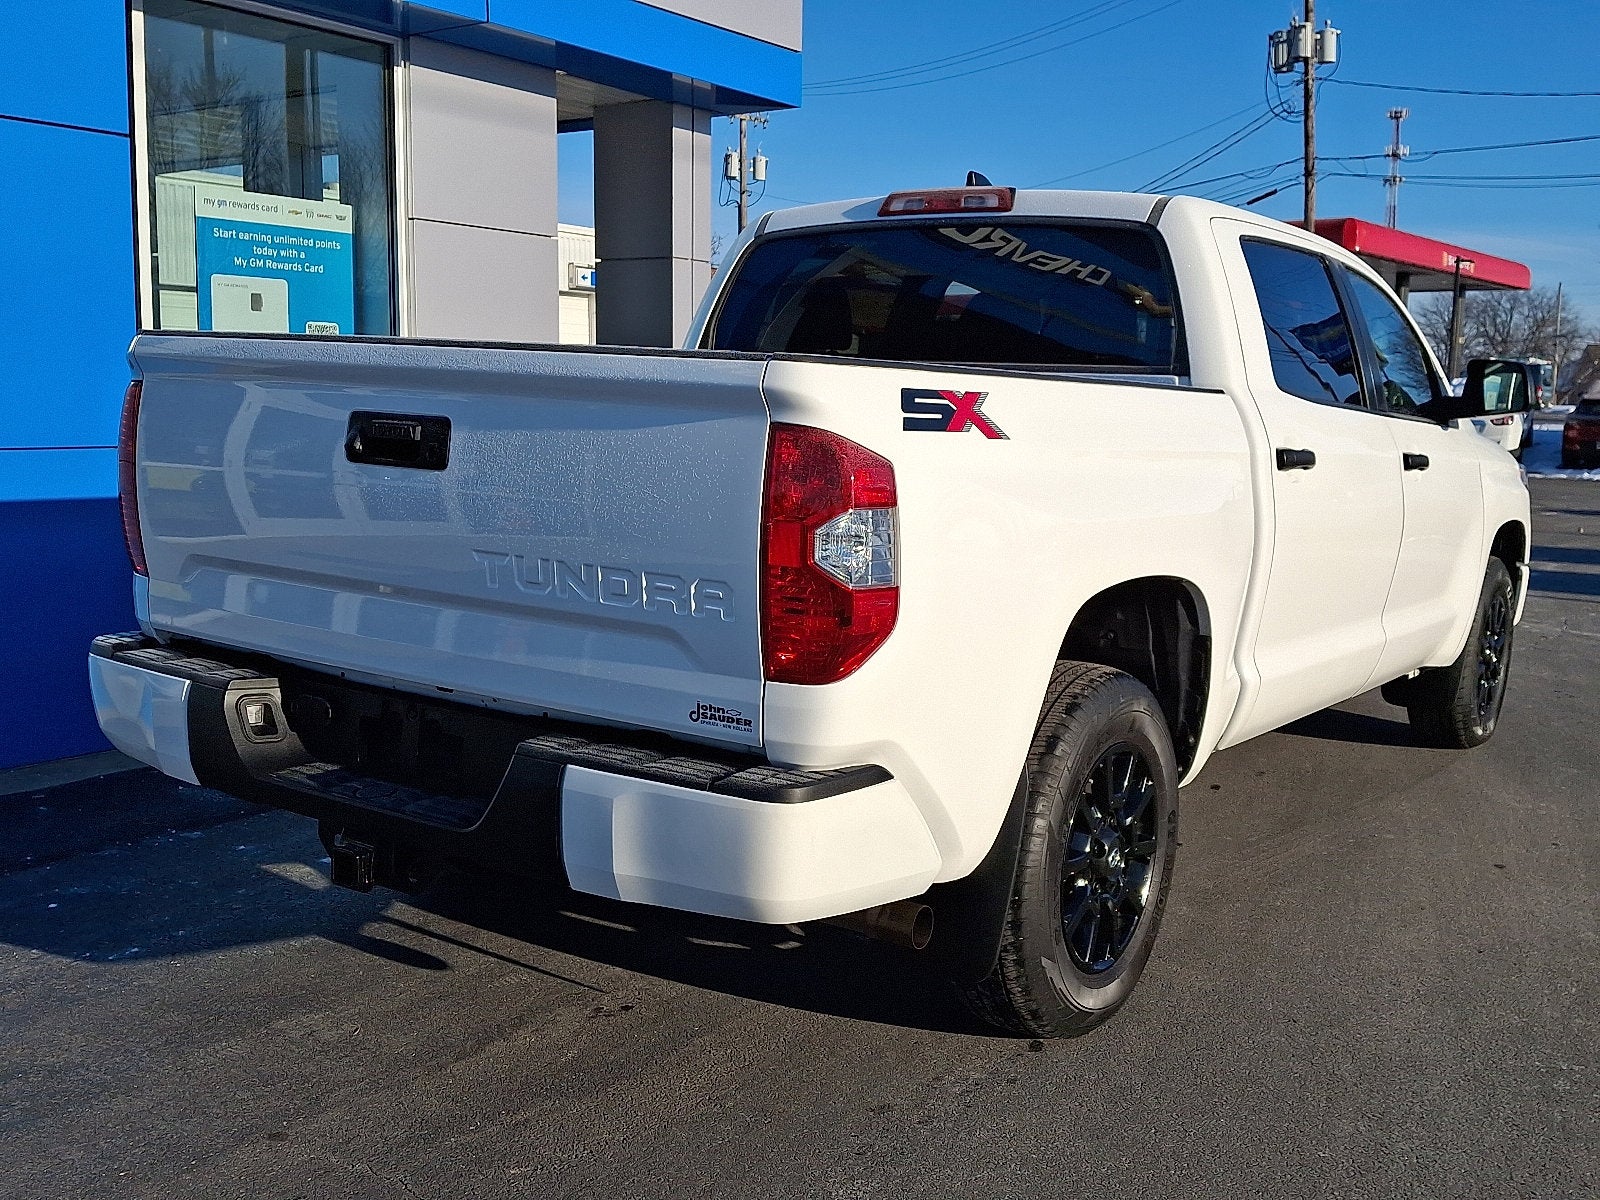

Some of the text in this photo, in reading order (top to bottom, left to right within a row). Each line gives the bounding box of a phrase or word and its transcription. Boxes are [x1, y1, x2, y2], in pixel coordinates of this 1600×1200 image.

[203, 197, 215, 208] my
[229, 200, 259, 211] rewards
[261, 204, 279, 213] card
[213, 227, 341, 250] Start earning unlimited points
[253, 245, 306, 259] today with a
[234, 256, 324, 273] My GM Rewards Card
[472, 549, 735, 622] TUNDRA
[700, 712, 753, 728] SAUDER
